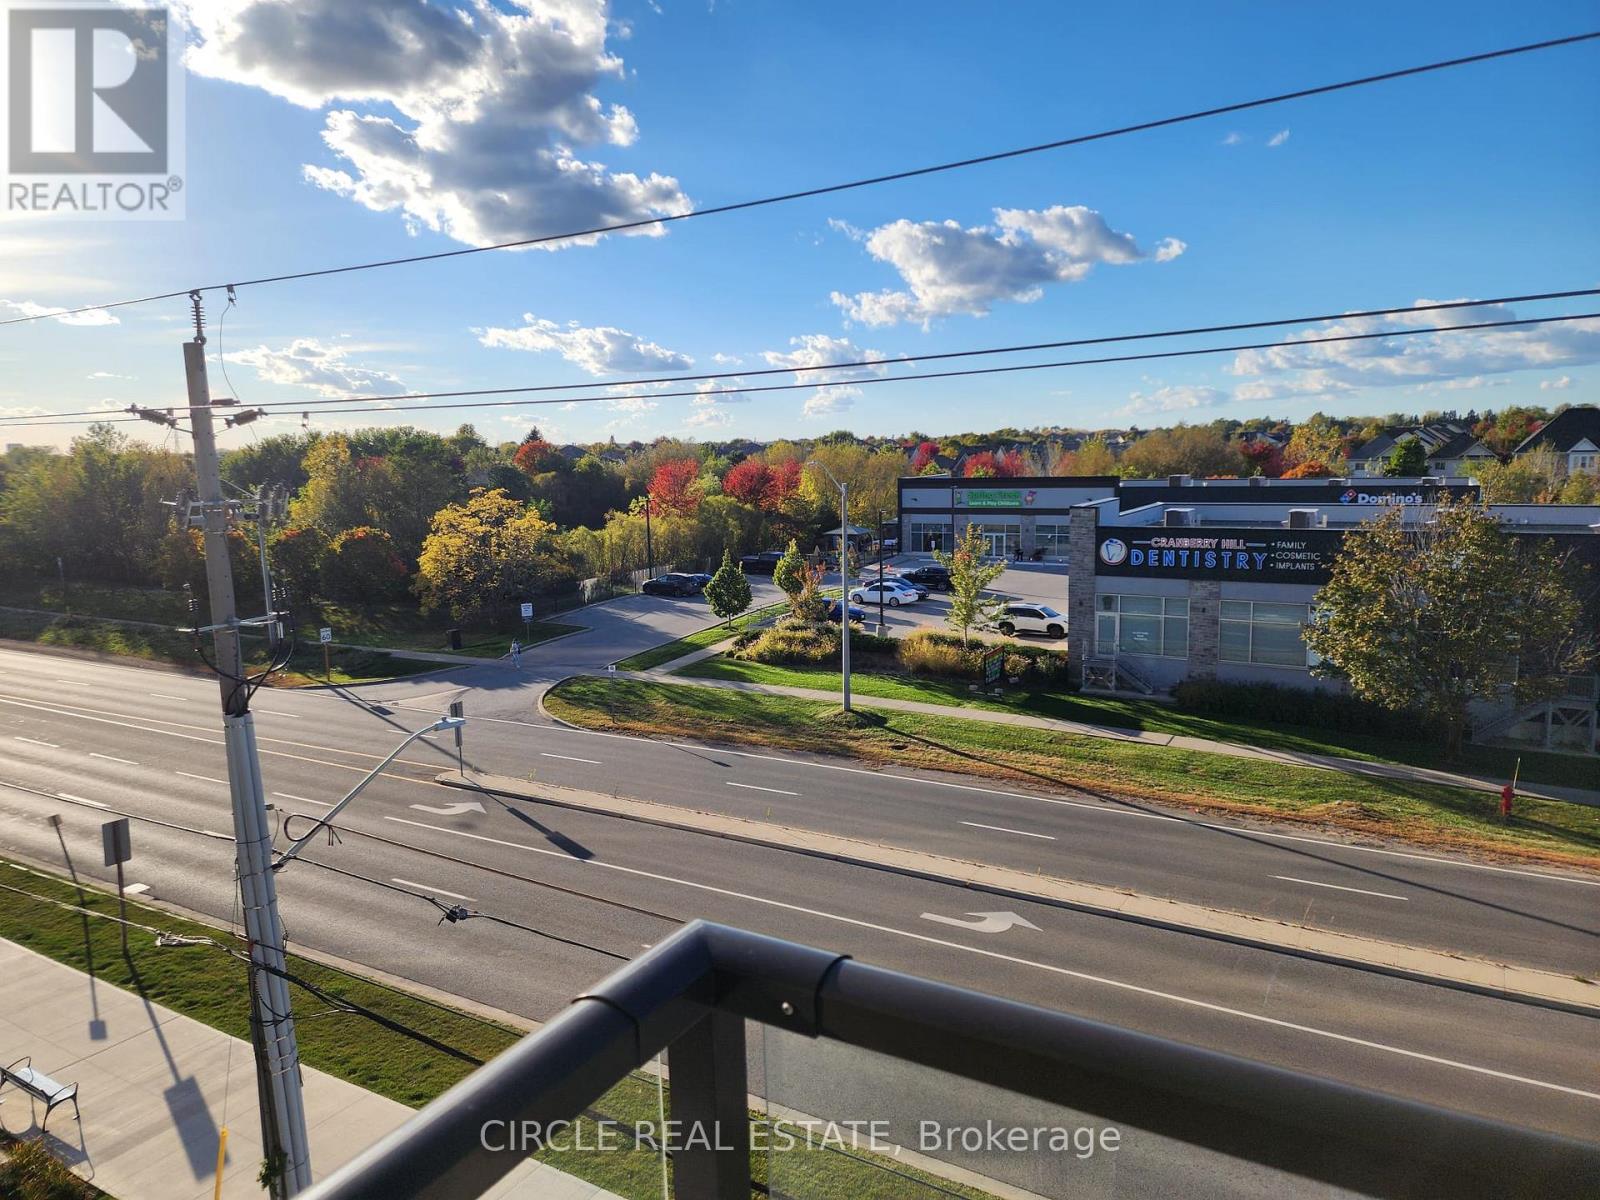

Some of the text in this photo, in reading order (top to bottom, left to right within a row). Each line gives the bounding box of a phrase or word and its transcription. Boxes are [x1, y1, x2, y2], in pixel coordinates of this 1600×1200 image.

[1358, 492, 1422, 504] Domino's
[1150, 537, 1246, 549] CRANBERRY HILL
[1276, 541, 1307, 549] FAMILY
[1130, 549, 1267, 570] DENTISTRY
[1275, 551, 1321, 560] COSMETIC
[1275, 562, 1315, 570] IMPLANTS
